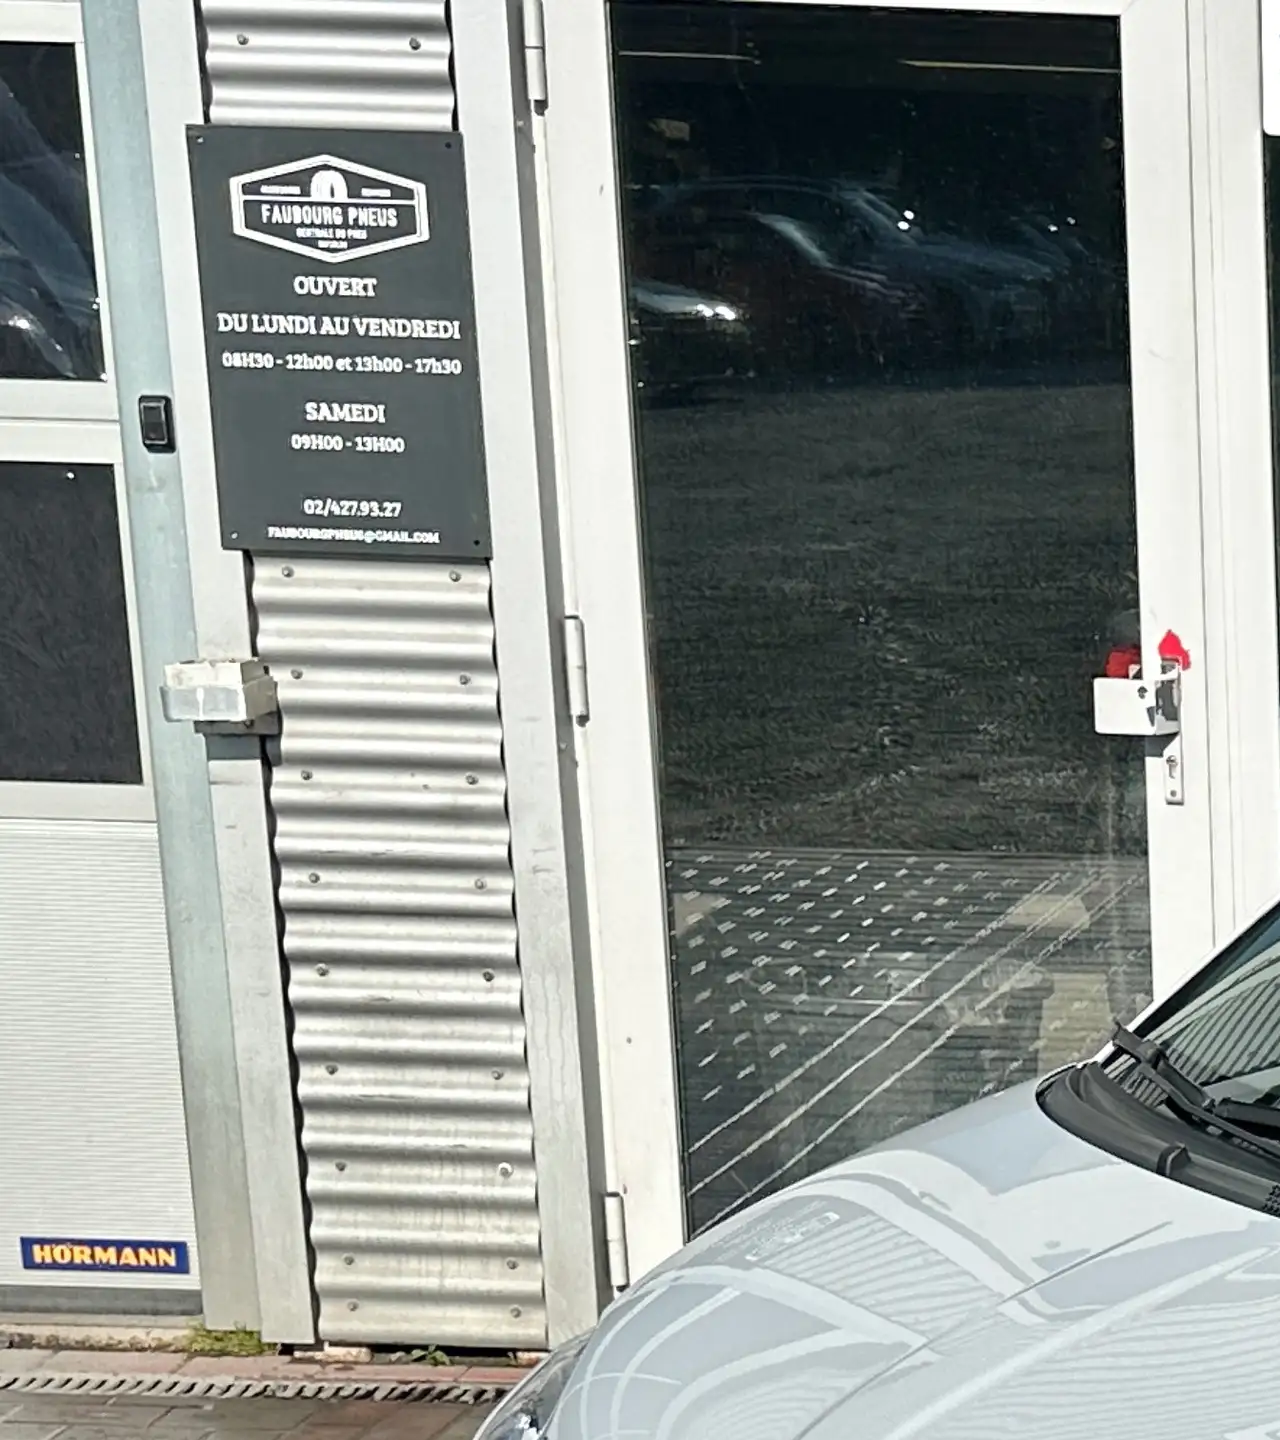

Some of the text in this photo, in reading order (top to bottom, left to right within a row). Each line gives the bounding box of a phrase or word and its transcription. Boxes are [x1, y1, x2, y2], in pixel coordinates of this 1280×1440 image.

[260, 203, 399, 228] FAUBOURG PNEUS
[292, 275, 378, 297] OUVERT
[216, 312, 461, 339] DU LUNDI AU VENDREDI
[285, 353, 334, 371] 12h00
[335, 356, 352, 372] et
[355, 355, 404, 373] 13h00
[414, 358, 463, 375] 17h30
[304, 401, 386, 423] SAMEDI
[290, 434, 344, 451] 09H00
[354, 436, 406, 453] 13H00
[303, 498, 402, 518] 02/427.93.27
